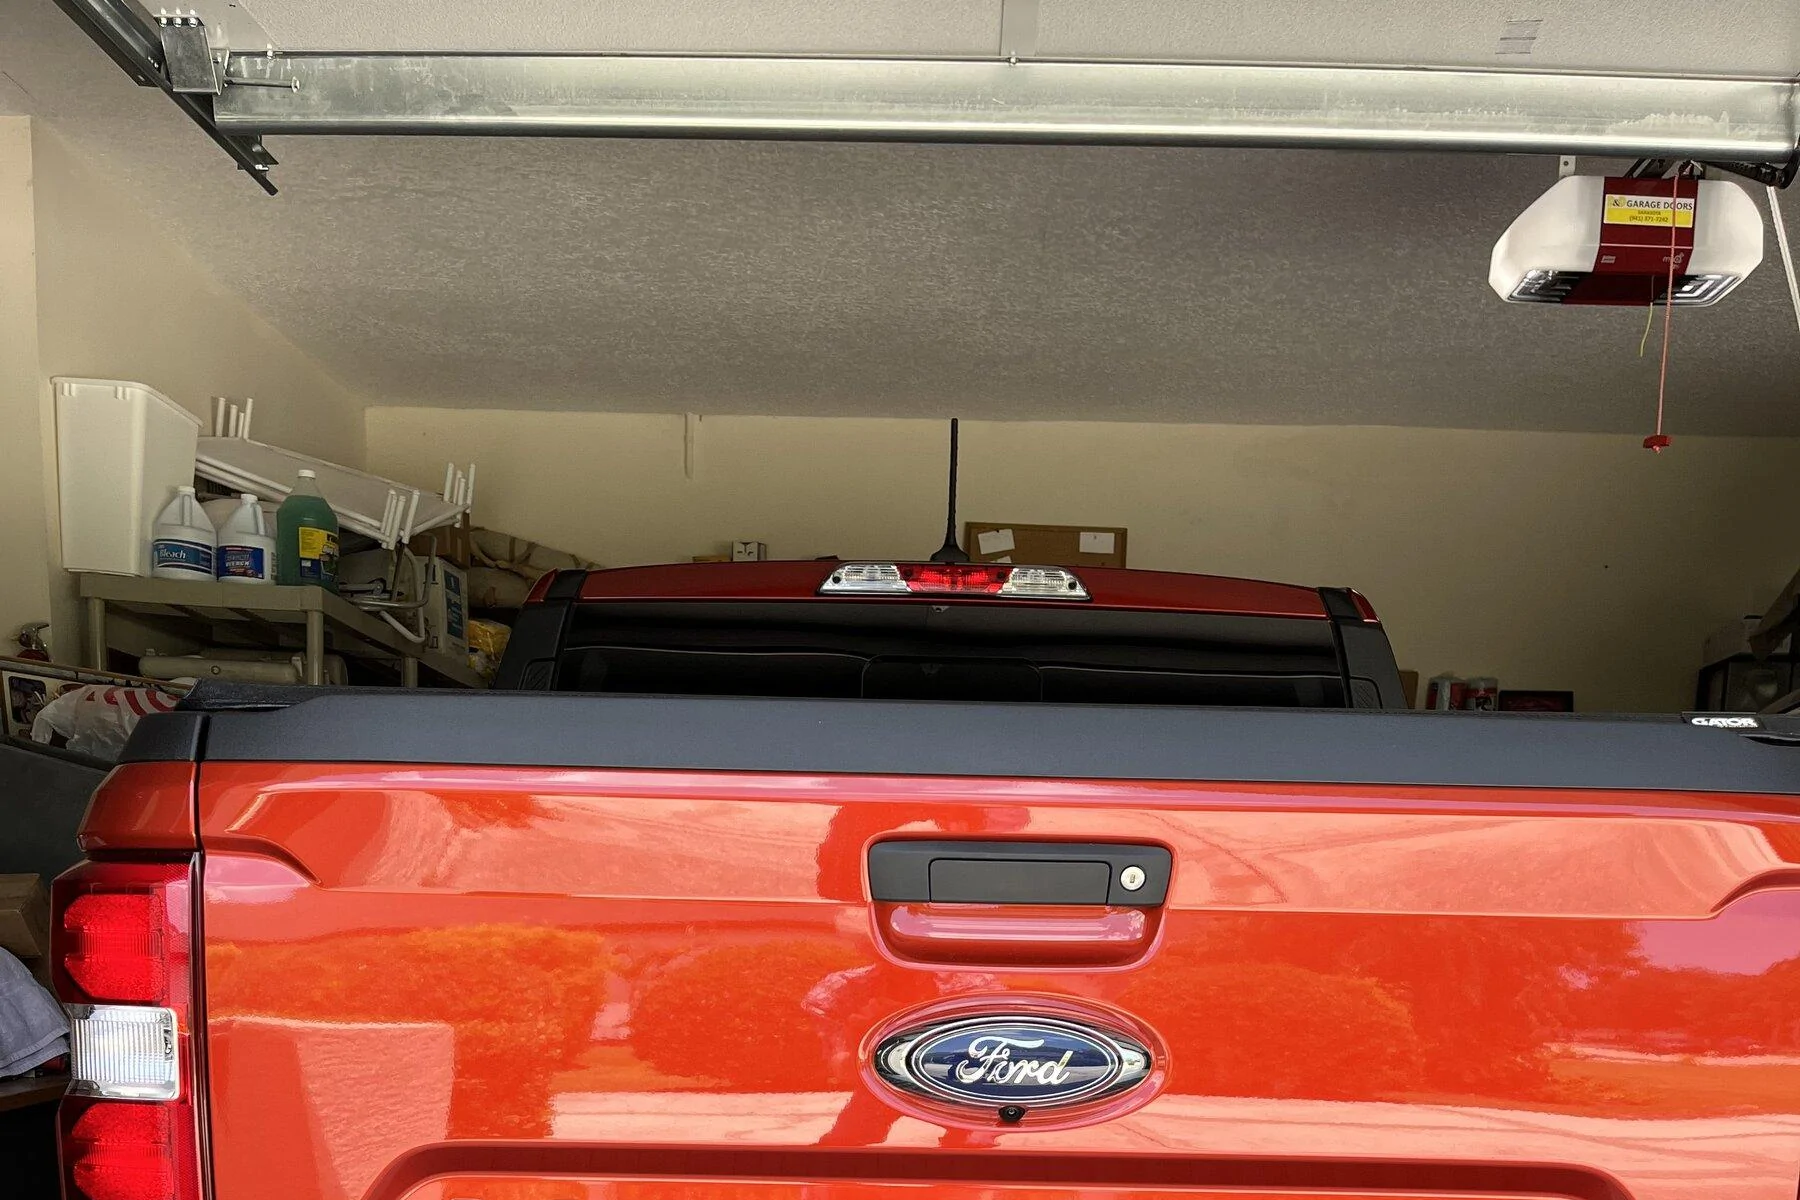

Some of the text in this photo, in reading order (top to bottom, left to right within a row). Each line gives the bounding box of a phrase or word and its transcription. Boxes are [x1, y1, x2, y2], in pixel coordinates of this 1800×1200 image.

[1627, 200, 1660, 209] GARAGE
[159, 548, 186, 559] Bleach
[1691, 717, 1758, 728] GATOR
[955, 1035, 1072, 1084] Ford
